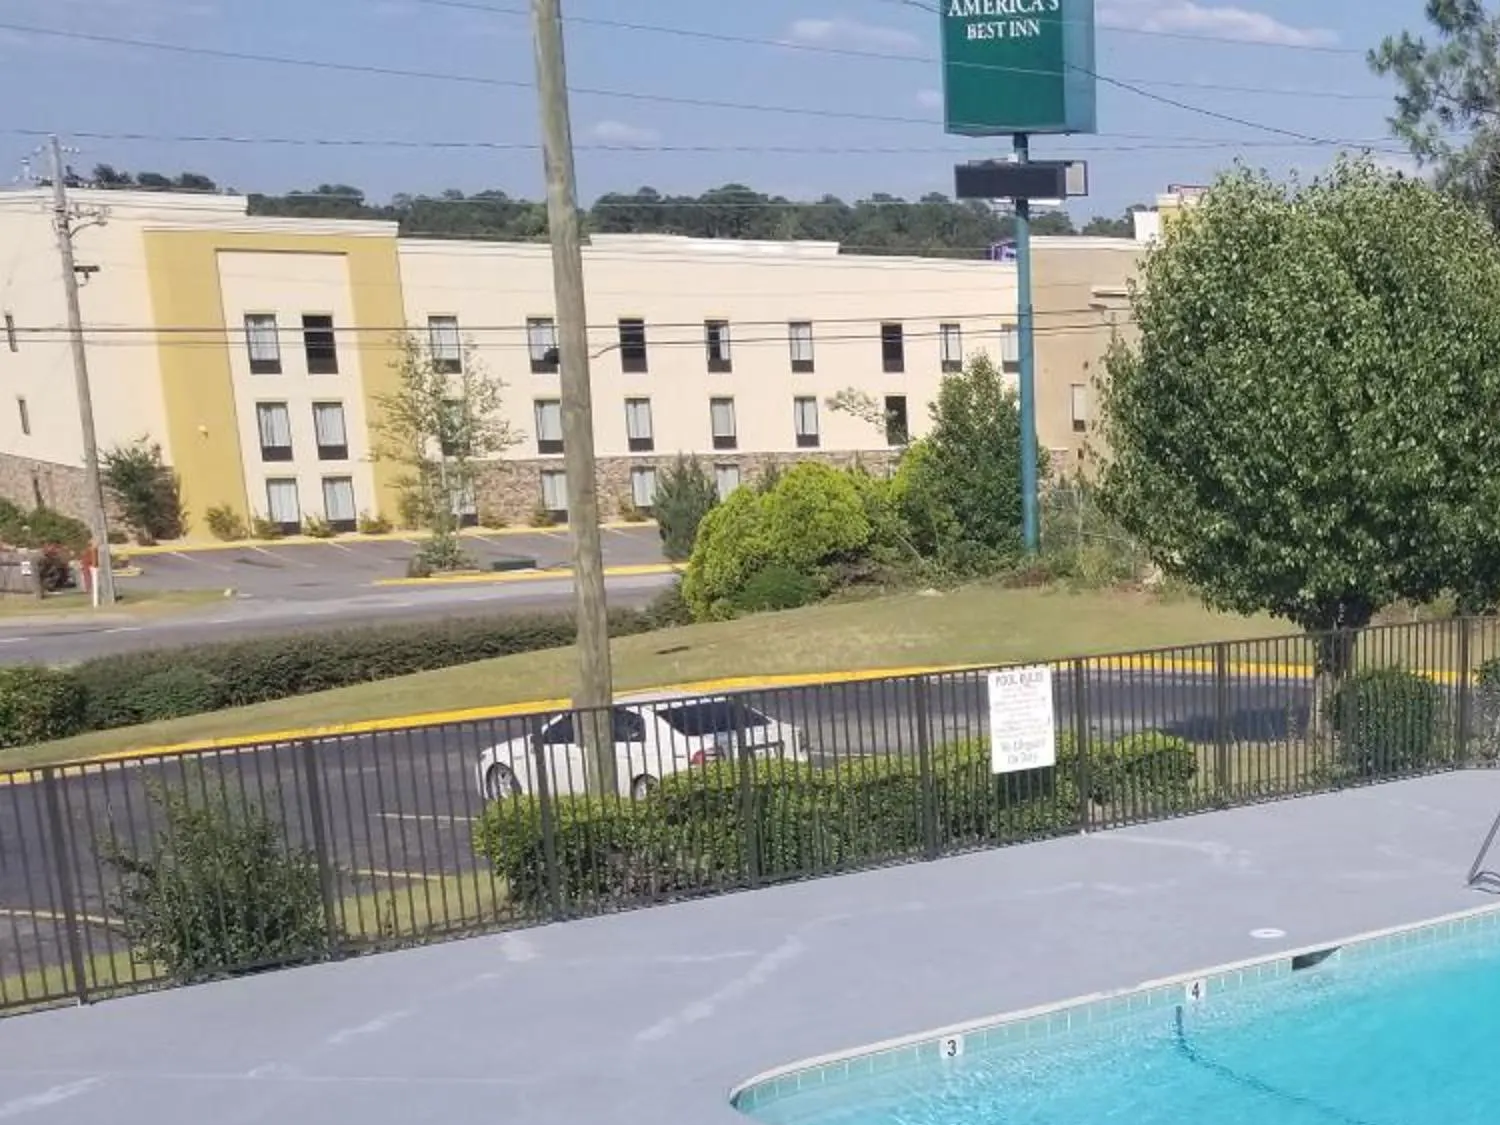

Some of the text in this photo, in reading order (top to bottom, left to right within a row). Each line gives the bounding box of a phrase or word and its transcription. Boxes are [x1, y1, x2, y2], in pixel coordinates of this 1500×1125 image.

[948, 0, 1059, 17] AMERICAS
[967, 20, 1041, 40] BEST INN
[1191, 981, 1200, 1000] 4
[947, 1039, 957, 1057] 3
